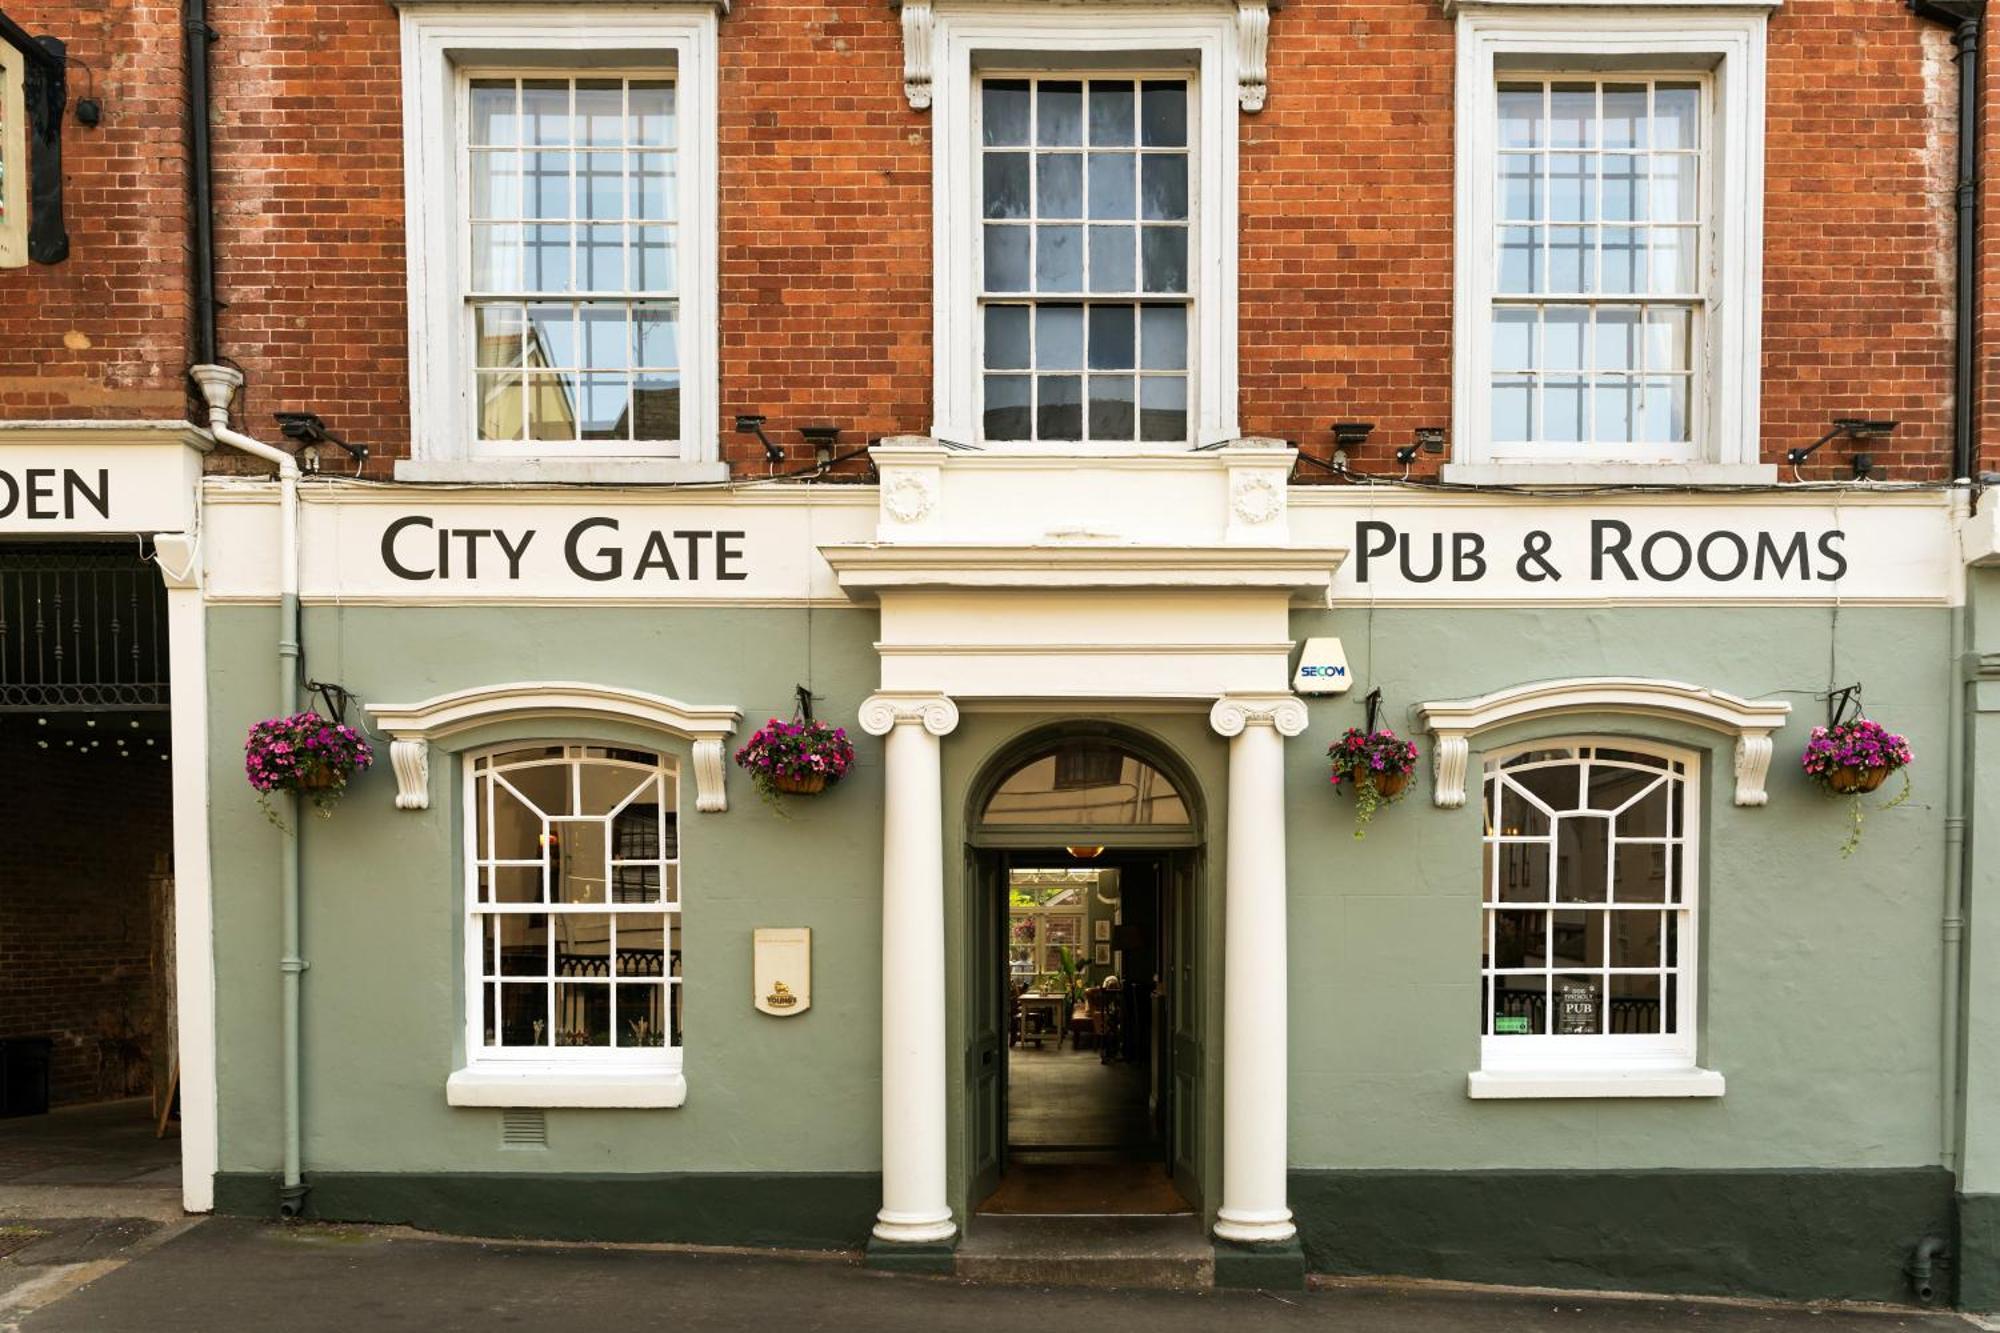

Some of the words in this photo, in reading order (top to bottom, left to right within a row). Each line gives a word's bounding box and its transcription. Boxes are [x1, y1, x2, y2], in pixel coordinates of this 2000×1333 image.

[381, 515, 536, 581] CITY
[564, 516, 748, 582] GATE
[1356, 520, 1487, 583] PUB
[1516, 530, 1562, 582] &
[1591, 519, 1847, 582] ROOMS
[1301, 665, 1345, 677] SECOM
[1566, 1003, 1592, 1014] PUB
